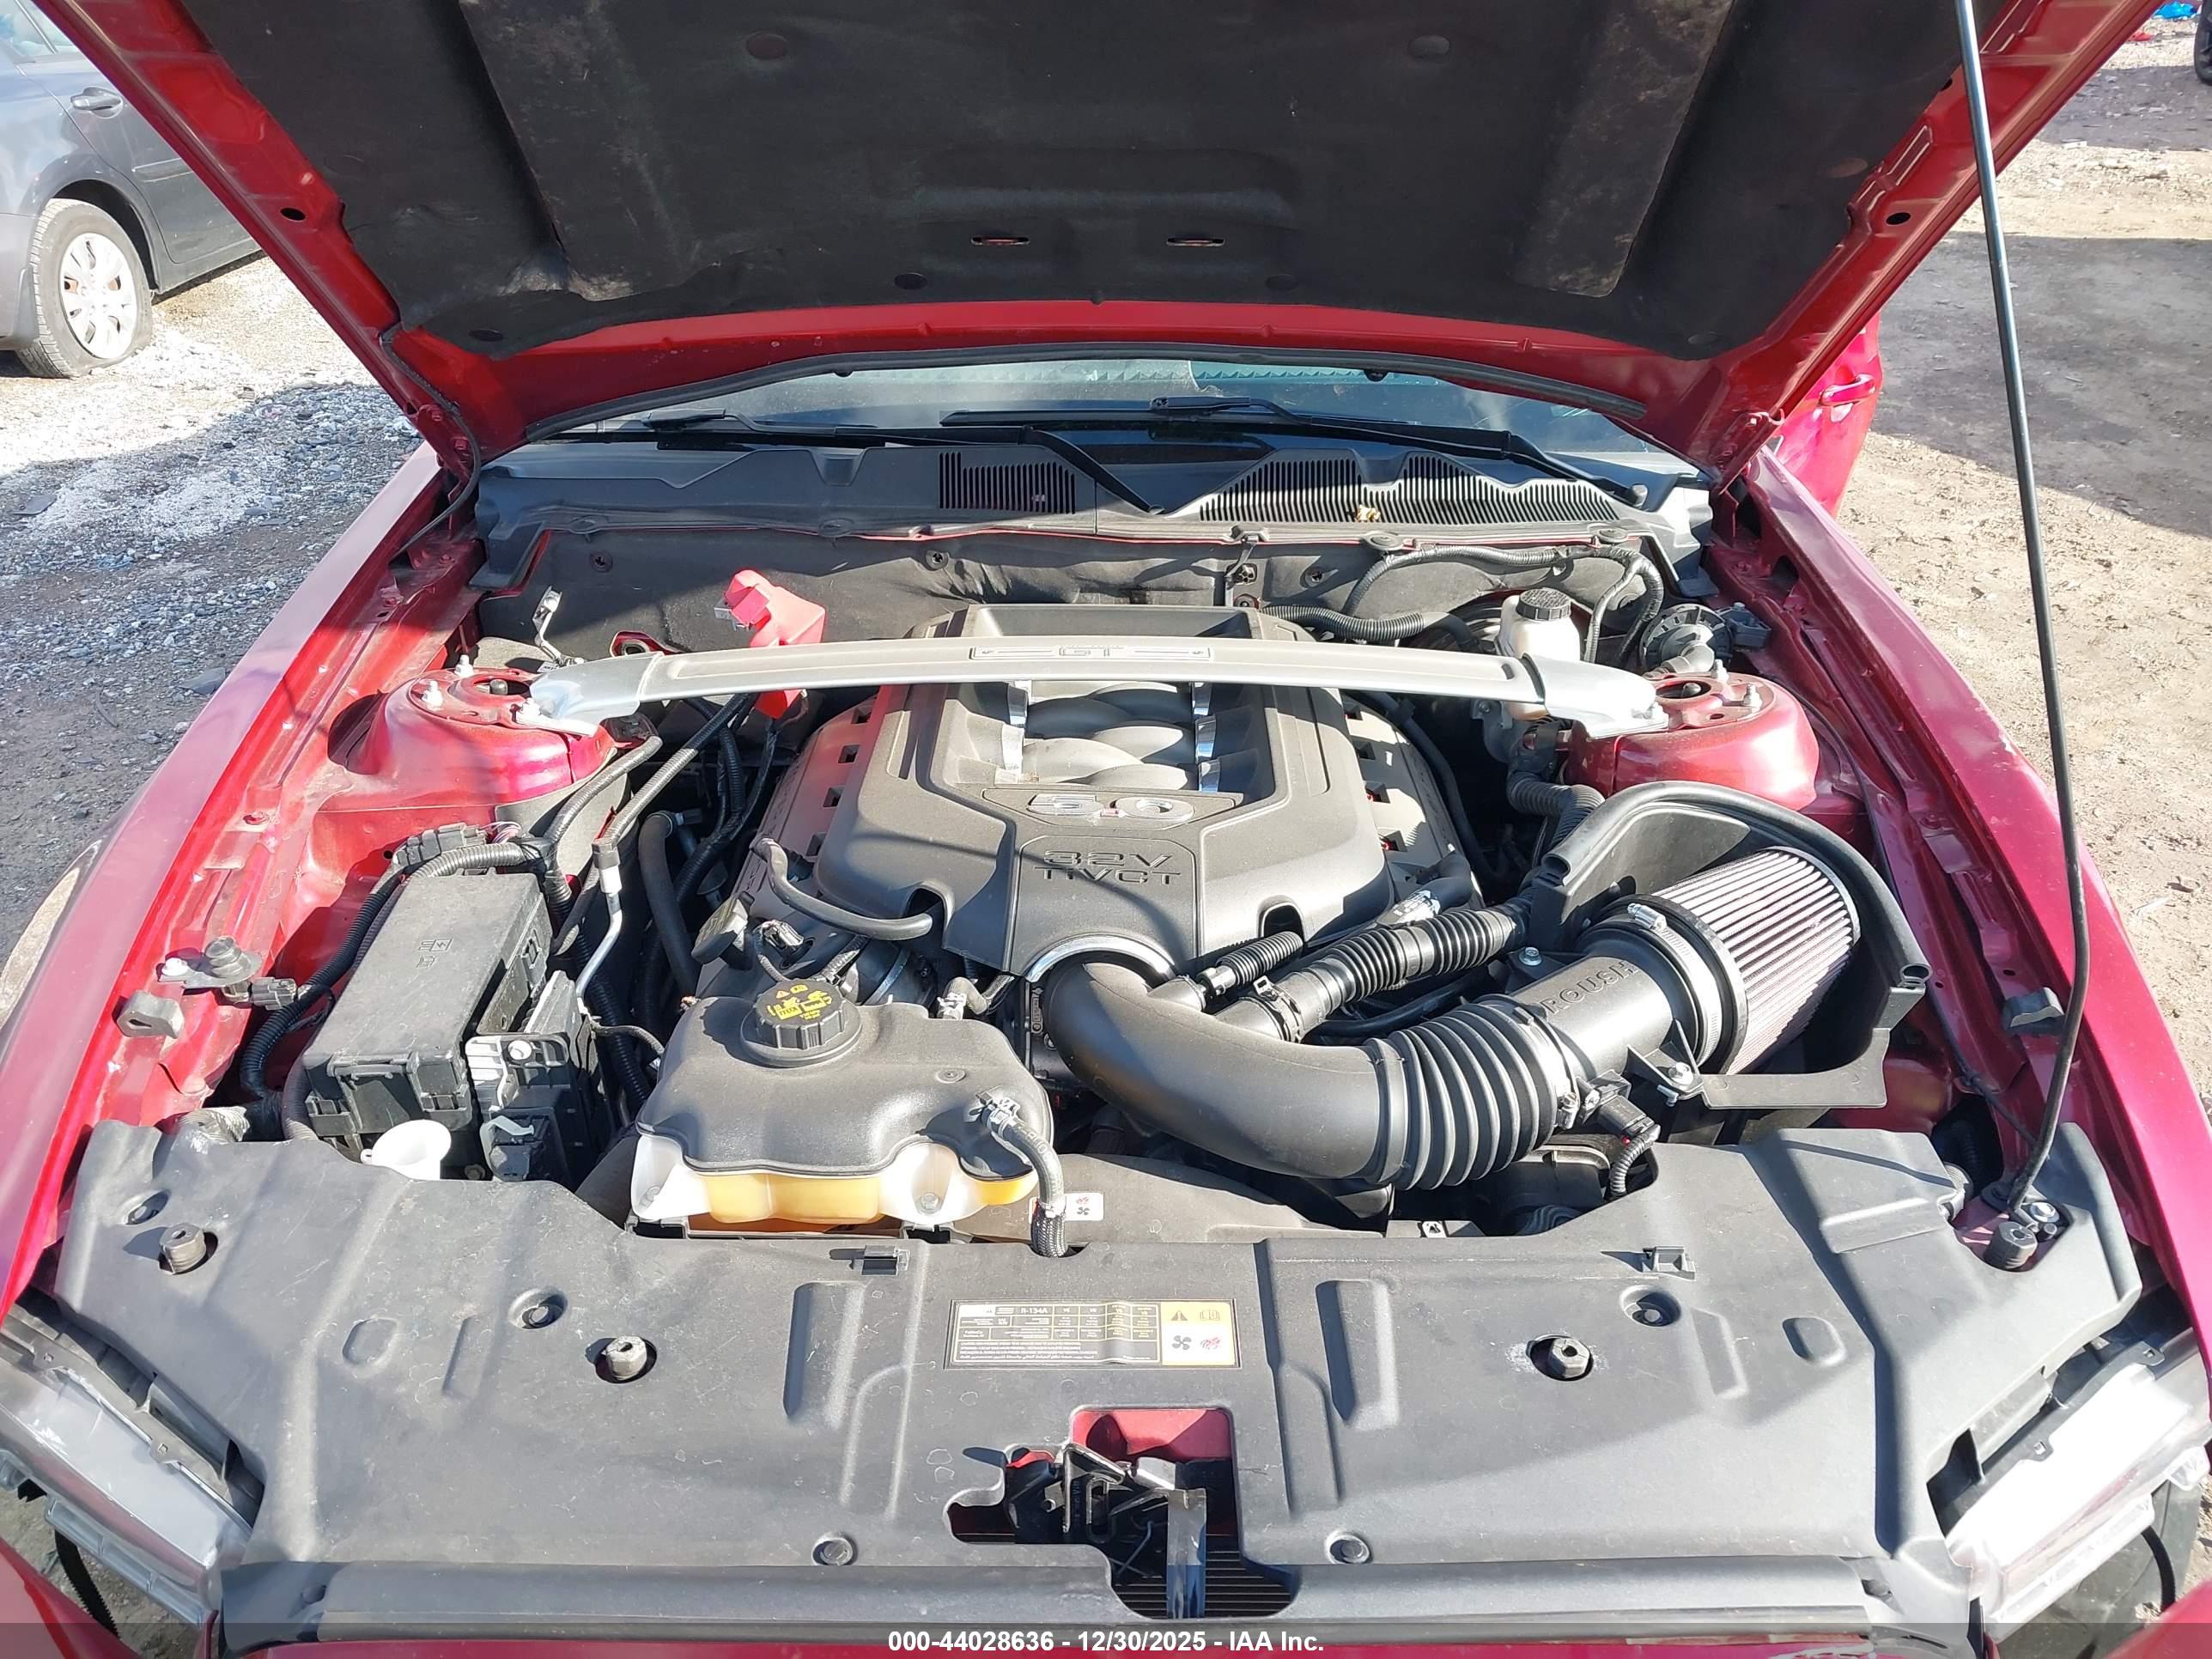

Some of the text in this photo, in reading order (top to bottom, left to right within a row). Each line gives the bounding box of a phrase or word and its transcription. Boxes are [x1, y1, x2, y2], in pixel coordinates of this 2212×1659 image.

[1026, 794, 1195, 822] 5.0
[1043, 850, 1173, 868] 32V
[1539, 959, 1640, 1015] ROUSH
